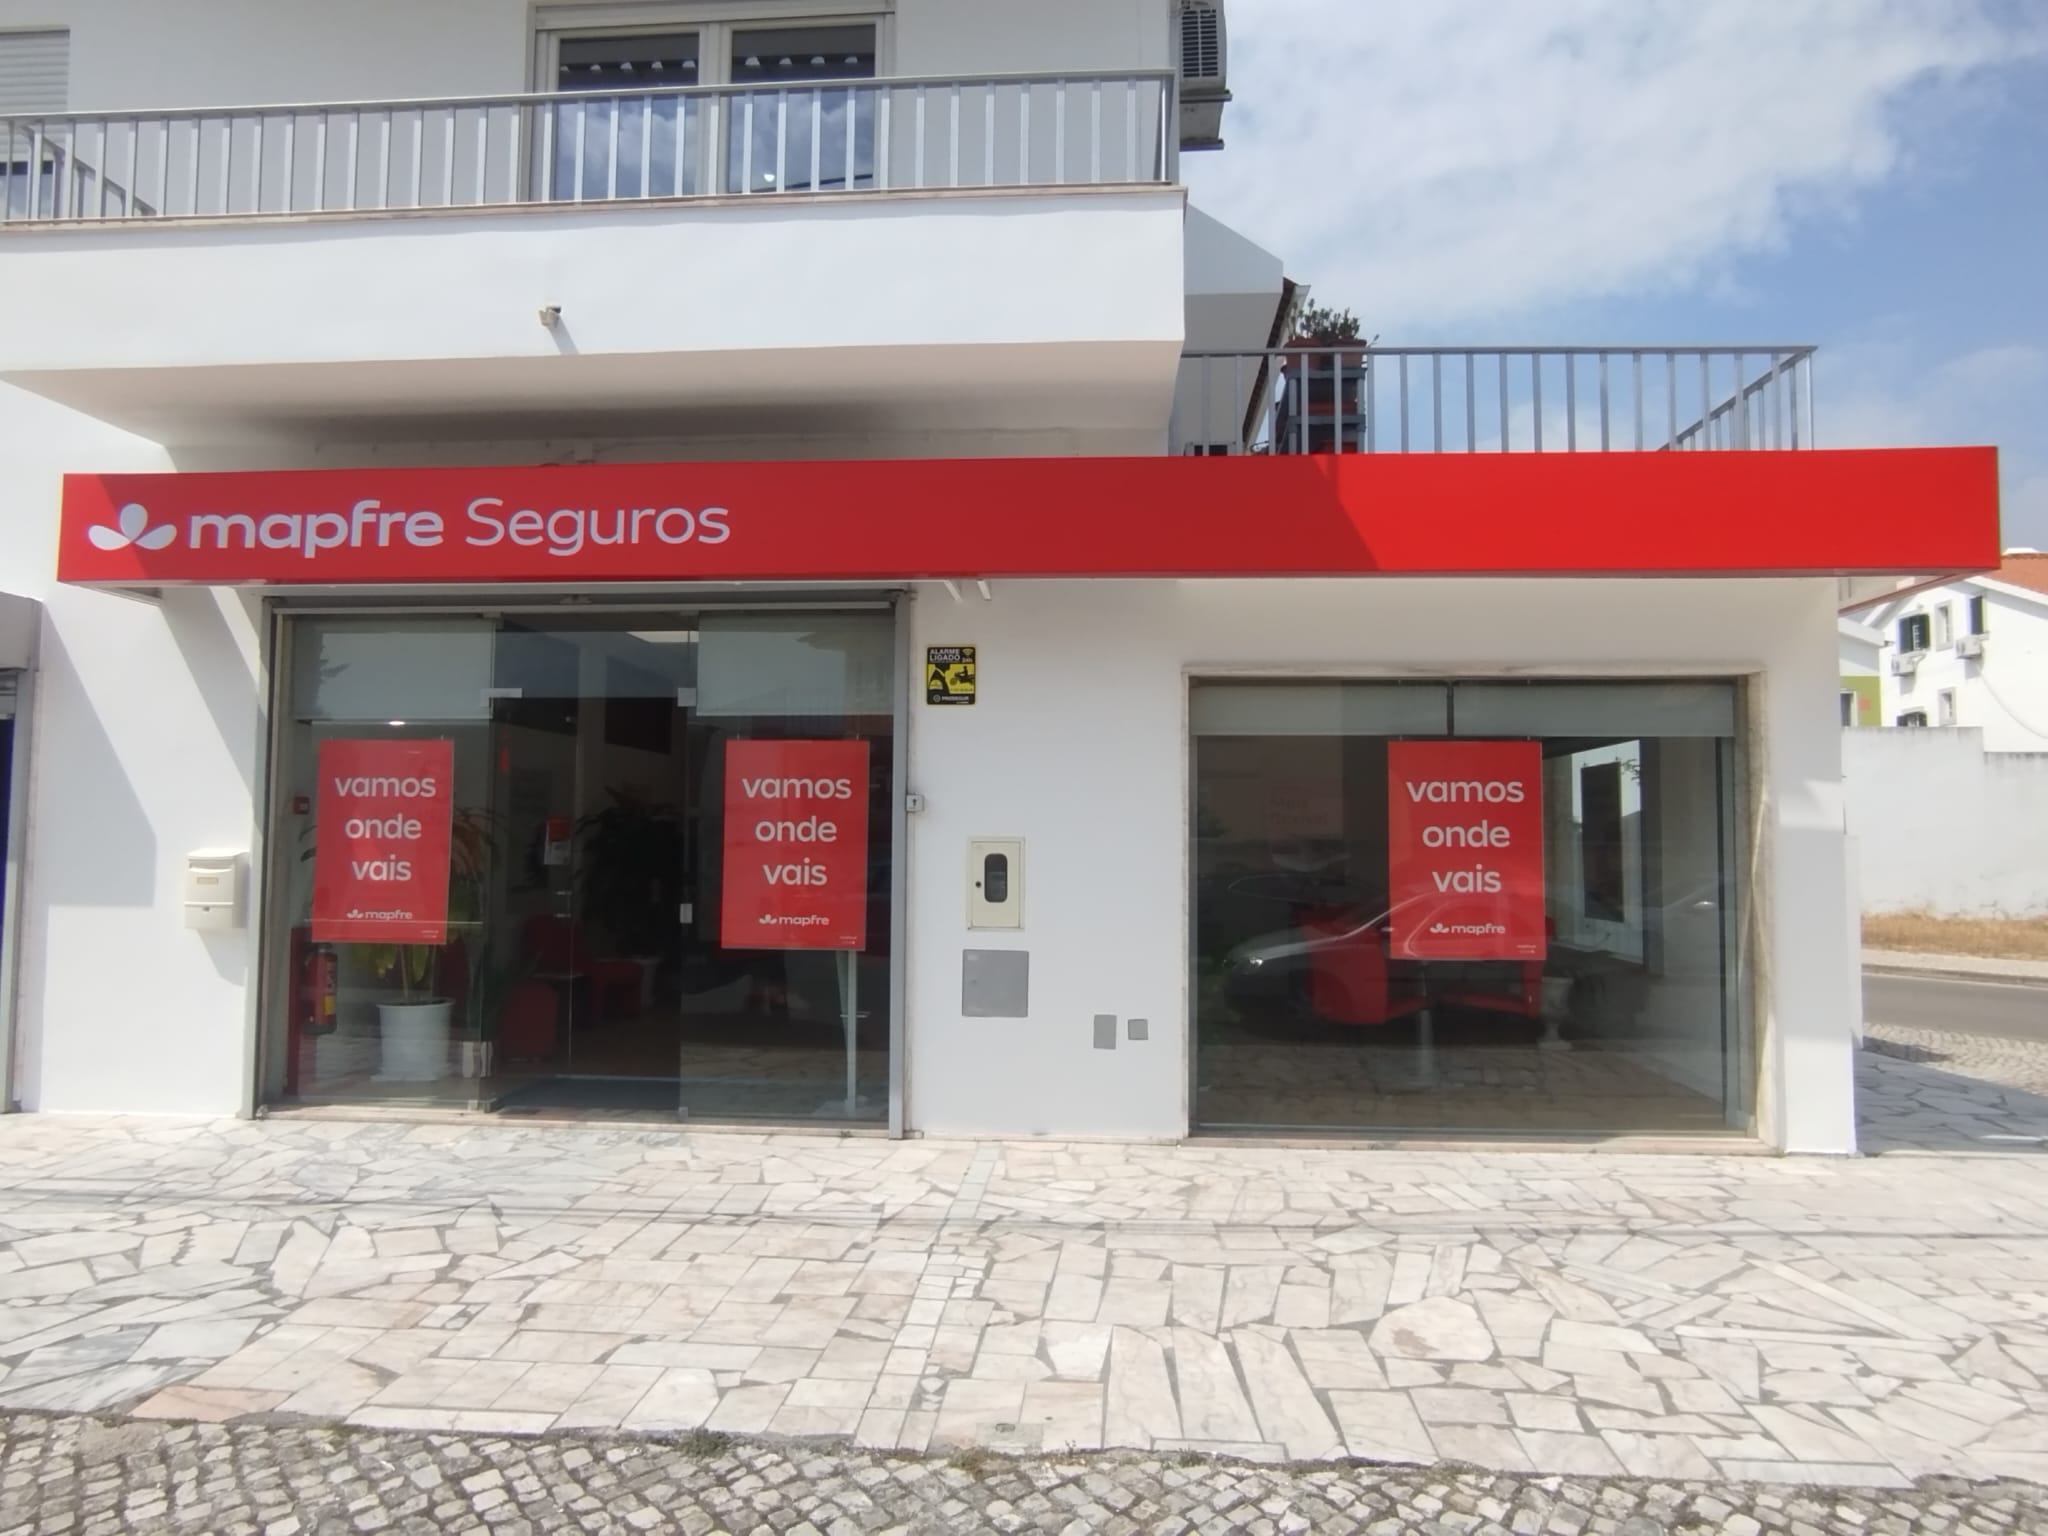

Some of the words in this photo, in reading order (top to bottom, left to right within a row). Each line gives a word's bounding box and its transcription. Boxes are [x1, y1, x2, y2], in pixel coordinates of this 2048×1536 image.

[189, 499, 444, 559] mapfre
[465, 497, 730, 557] Seguros
[929, 654, 961, 662] LIGADO
[335, 777, 436, 798] vamos
[741, 778, 852, 799] vamos
[1406, 781, 1525, 803] vamos
[345, 813, 422, 840] onde
[755, 815, 837, 842] onde
[1422, 819, 1510, 848] onde
[352, 854, 412, 881] vais
[762, 857, 828, 886] vais
[1432, 863, 1502, 893] vais
[364, 908, 413, 921] mapfre
[778, 914, 830, 927] mapfre
[1451, 923, 1506, 936] mapfre
